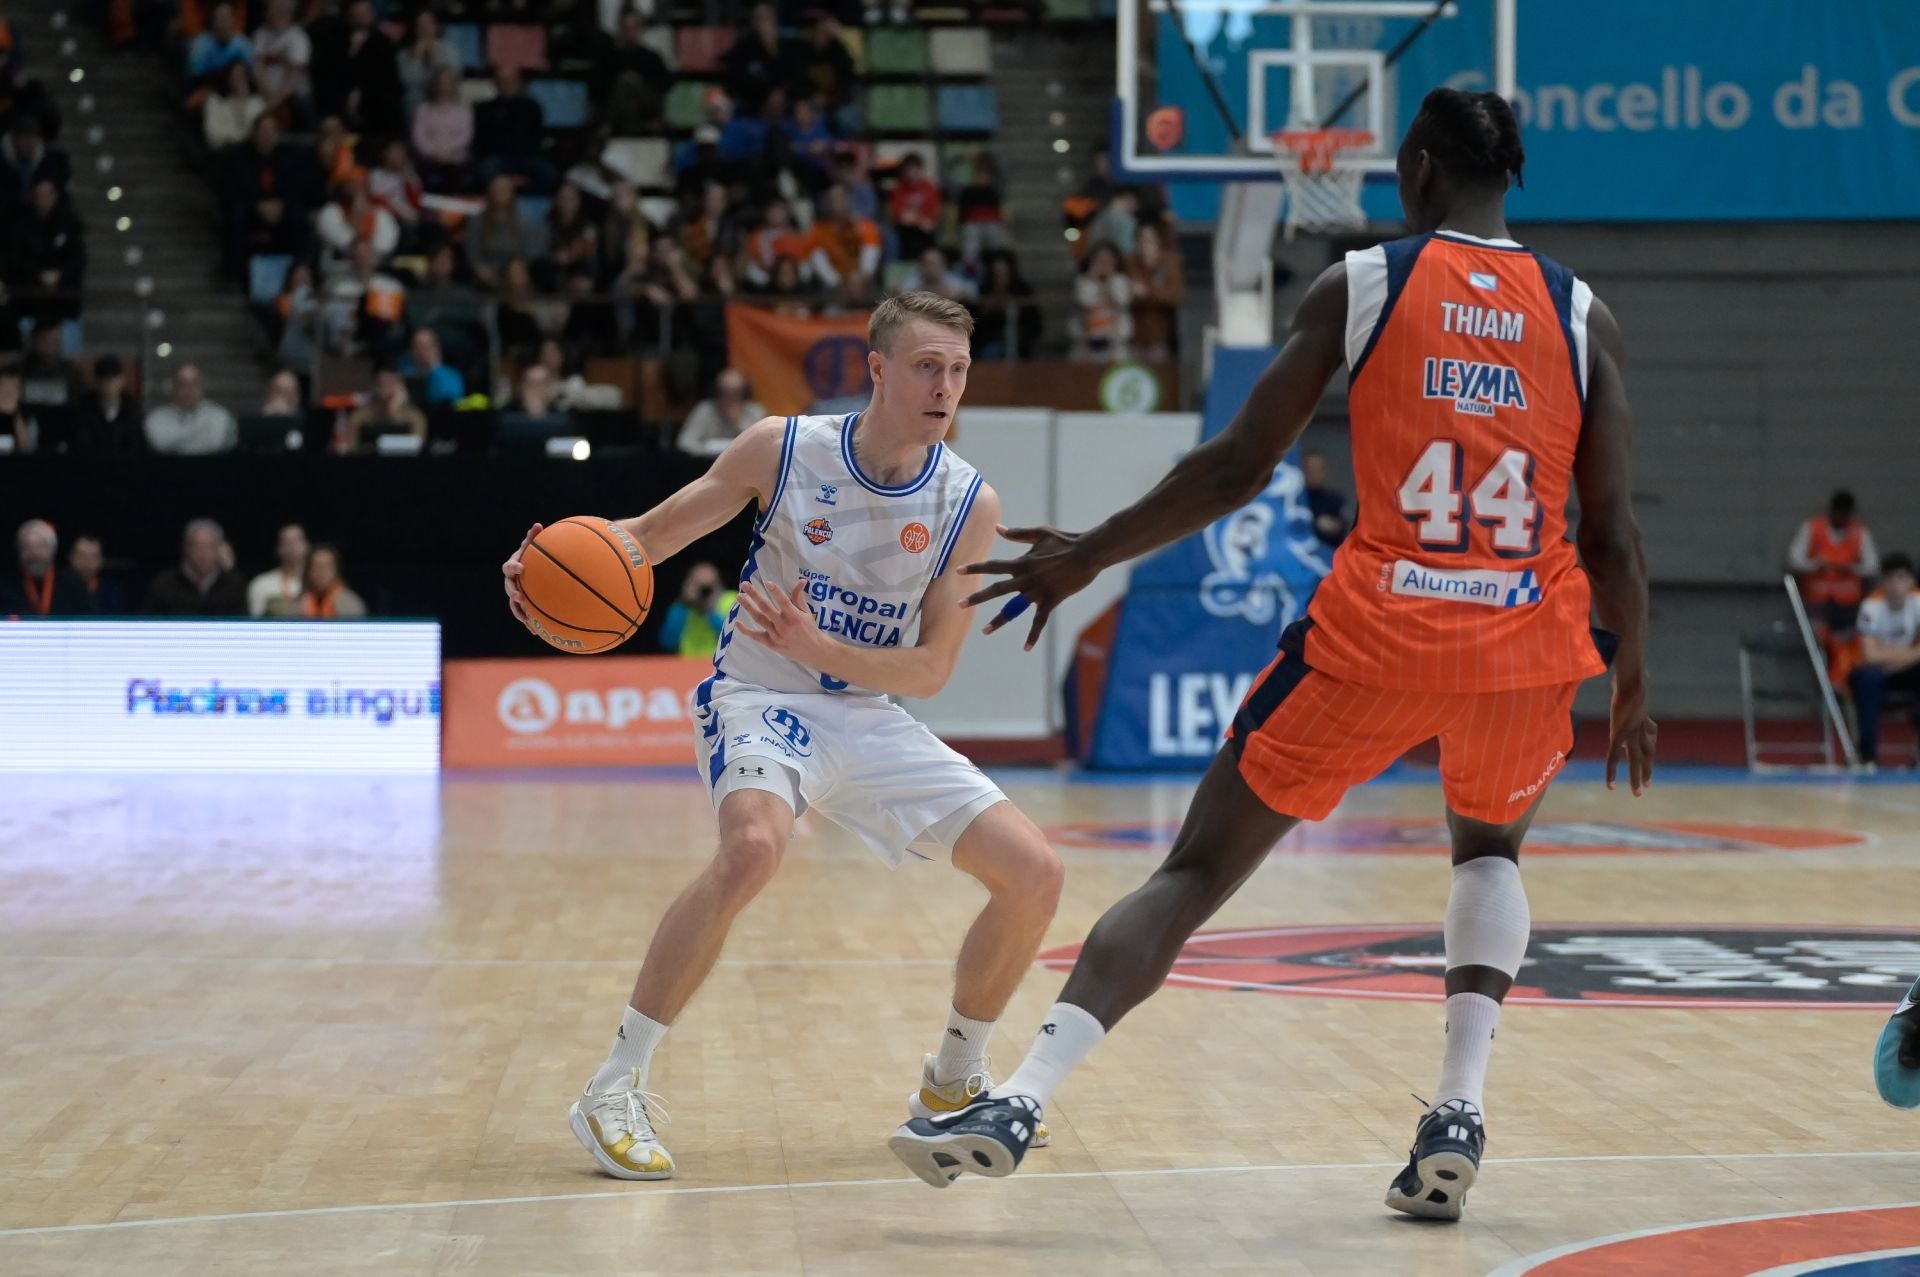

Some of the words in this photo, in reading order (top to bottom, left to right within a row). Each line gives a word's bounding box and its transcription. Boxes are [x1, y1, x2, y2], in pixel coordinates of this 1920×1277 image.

[1772, 64, 1863, 129] da
[1440, 301, 1525, 343] THIAM
[1423, 357, 1528, 410] LEYMA
[1456, 400, 1494, 414] NATURA
[1396, 438, 1542, 558] 44
[803, 524, 834, 541] PALENCIA
[1402, 569, 1499, 599] Aluman
[808, 603, 901, 647] LENCIA
